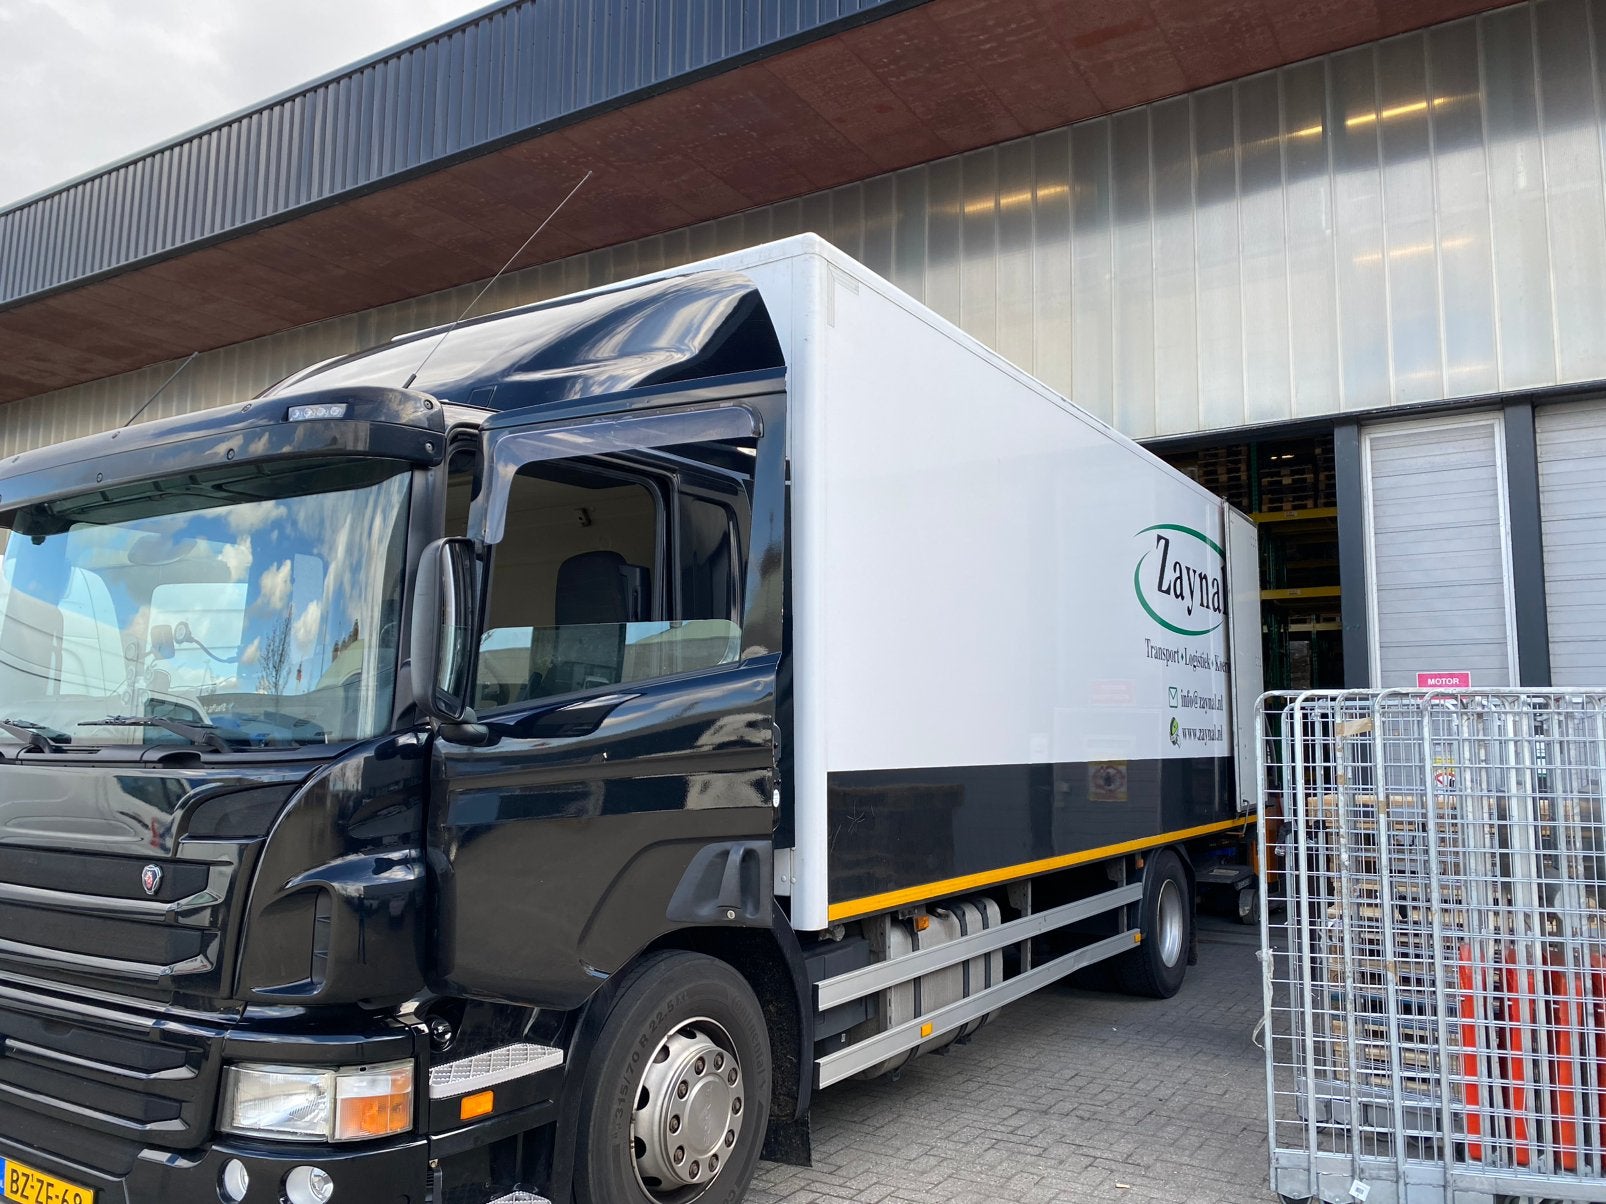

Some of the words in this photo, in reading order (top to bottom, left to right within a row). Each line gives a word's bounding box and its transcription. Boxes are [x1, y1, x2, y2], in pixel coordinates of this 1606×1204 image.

[1156, 534, 1227, 616] Zaynal
[1144, 638, 1180, 667] Transport
[1184, 647, 1211, 672] Logistiek
[1427, 677, 1460, 685] MOTOR
[1180, 689, 1224, 714] info@zaynal.nl
[1181, 723, 1223, 746] www.zaynal.nl
[614, 1050, 641, 1119] 315/70
[638, 1033, 649, 1048] R
[648, 999, 675, 1033] 22.5
